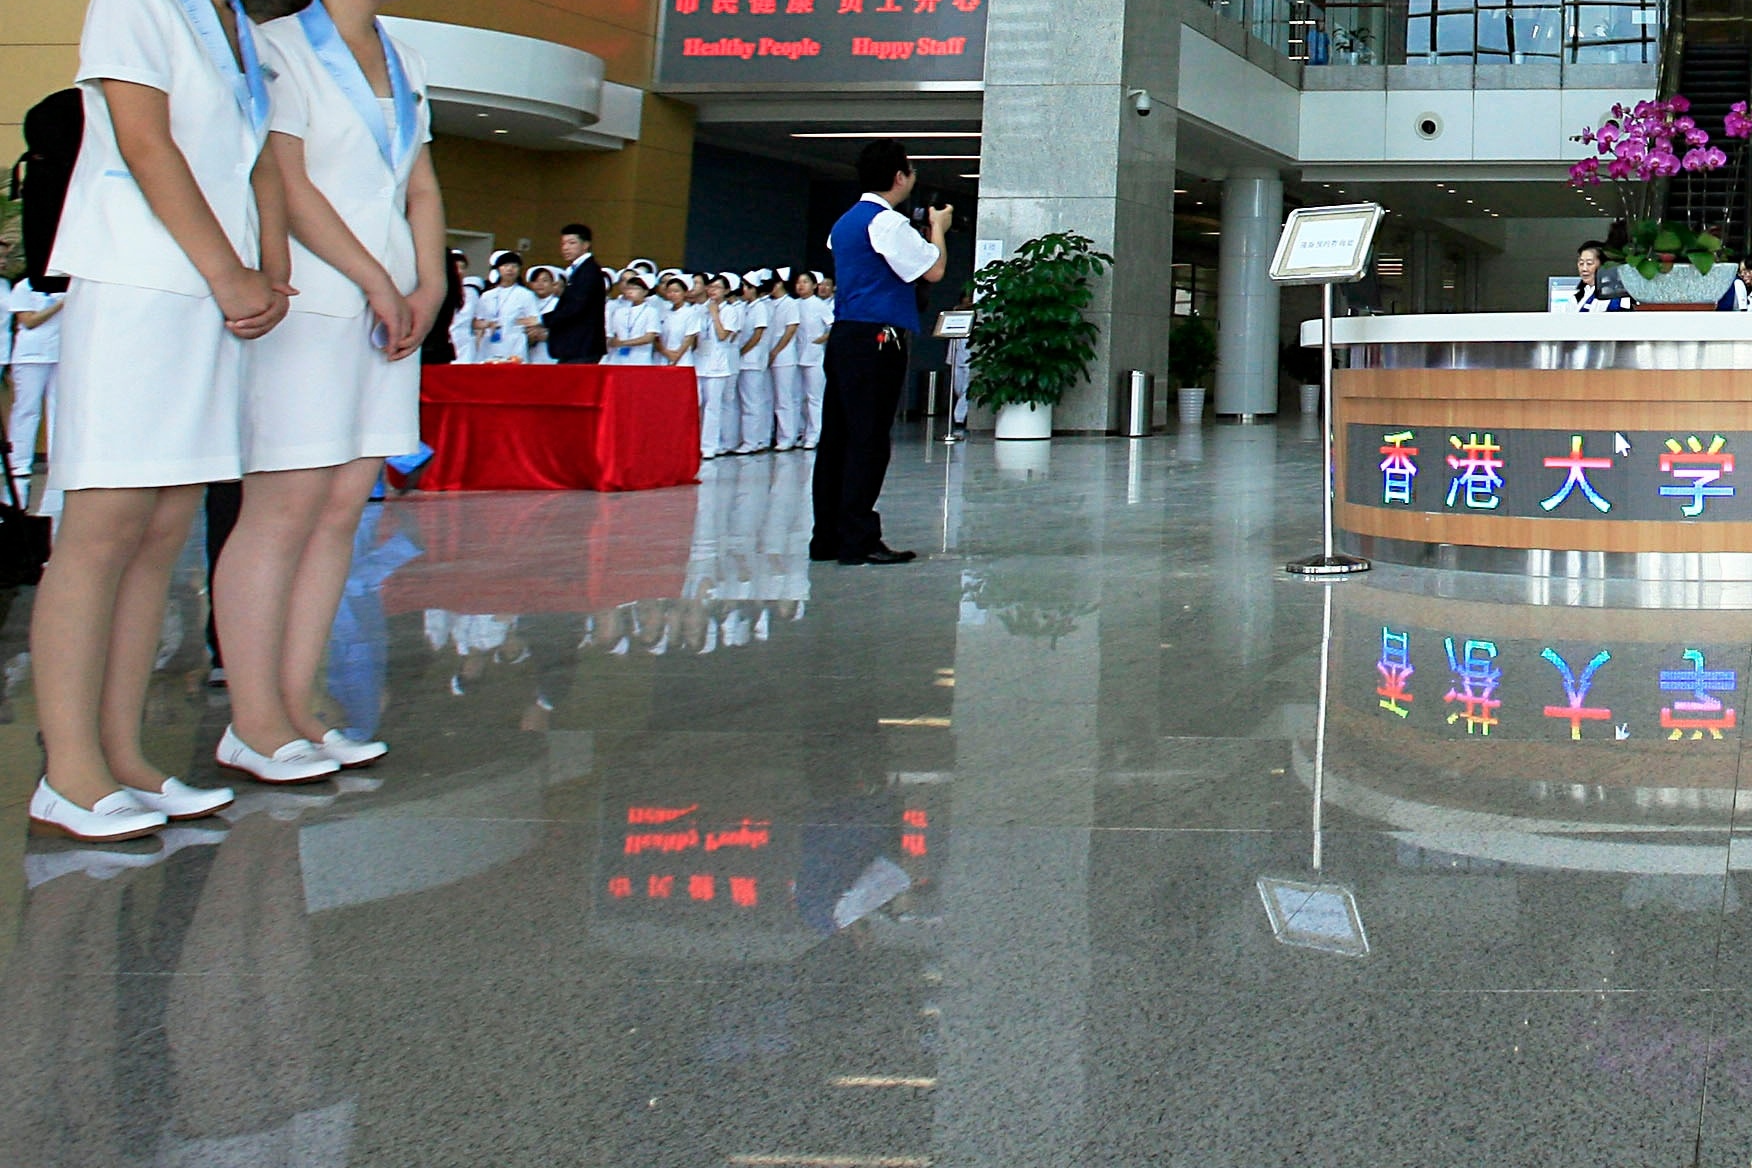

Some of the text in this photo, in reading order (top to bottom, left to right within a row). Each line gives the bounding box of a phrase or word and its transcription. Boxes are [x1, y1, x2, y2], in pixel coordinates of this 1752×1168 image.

[682, 37, 967, 60] Healthy People Happy Staff
